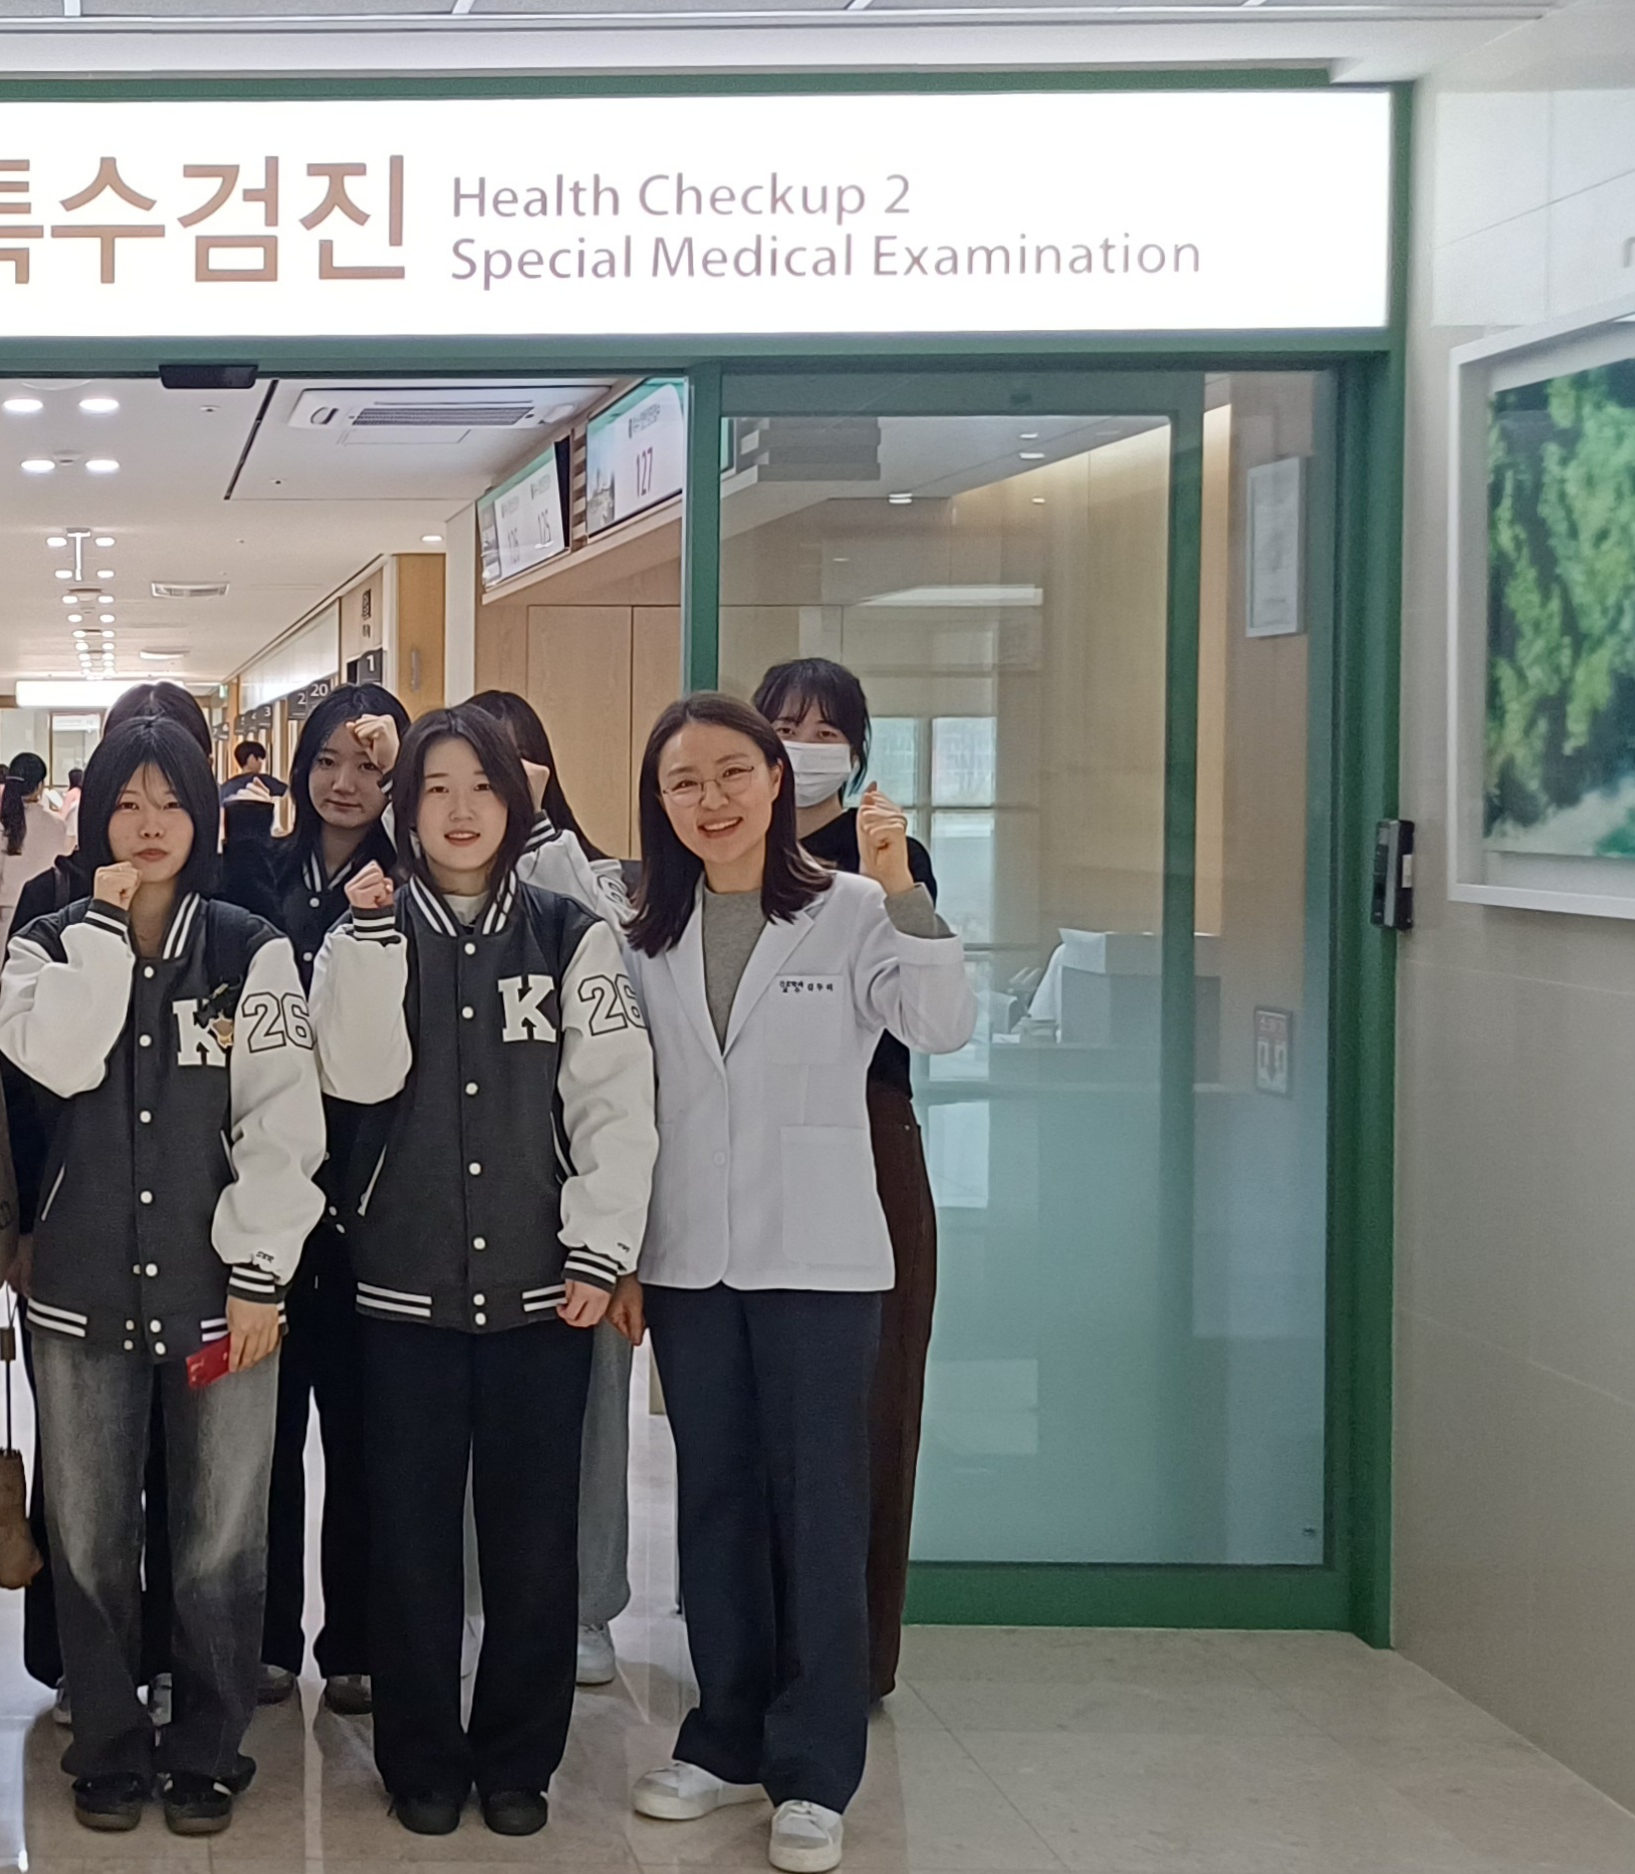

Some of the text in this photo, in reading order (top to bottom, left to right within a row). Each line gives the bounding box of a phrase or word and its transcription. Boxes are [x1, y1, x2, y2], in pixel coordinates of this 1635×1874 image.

[452, 172, 910, 224] Health Checkup 2
[451, 232, 1202, 291] Special Medical Examination
[310, 683, 328, 697] 20
[172, 992, 316, 1068] K 26
[497, 973, 648, 1043] K 26
